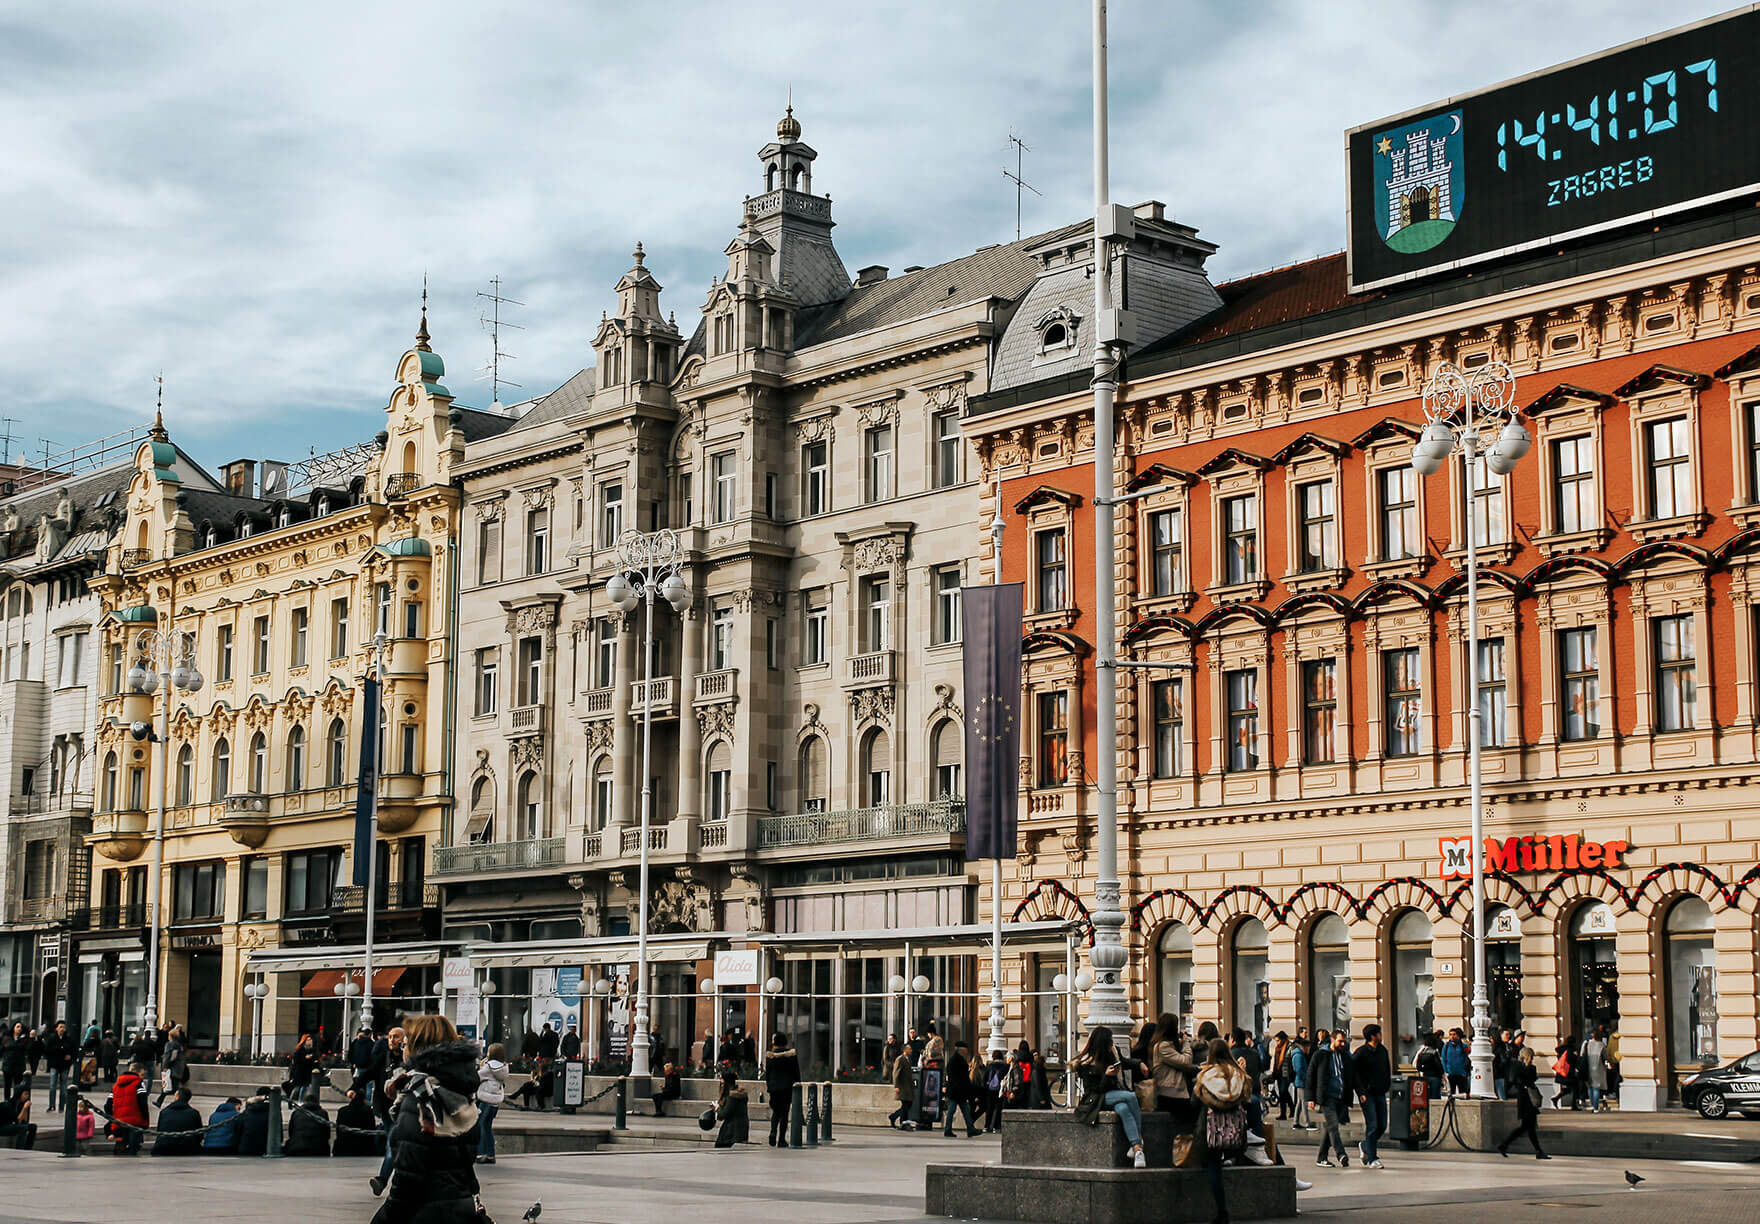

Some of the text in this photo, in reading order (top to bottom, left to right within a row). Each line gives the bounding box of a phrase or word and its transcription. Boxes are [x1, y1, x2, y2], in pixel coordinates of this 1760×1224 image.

[1497, 58, 1718, 172] 14:41:07
[1547, 156, 1654, 207] ZAGREB
[1483, 833, 1627, 874] Müller
